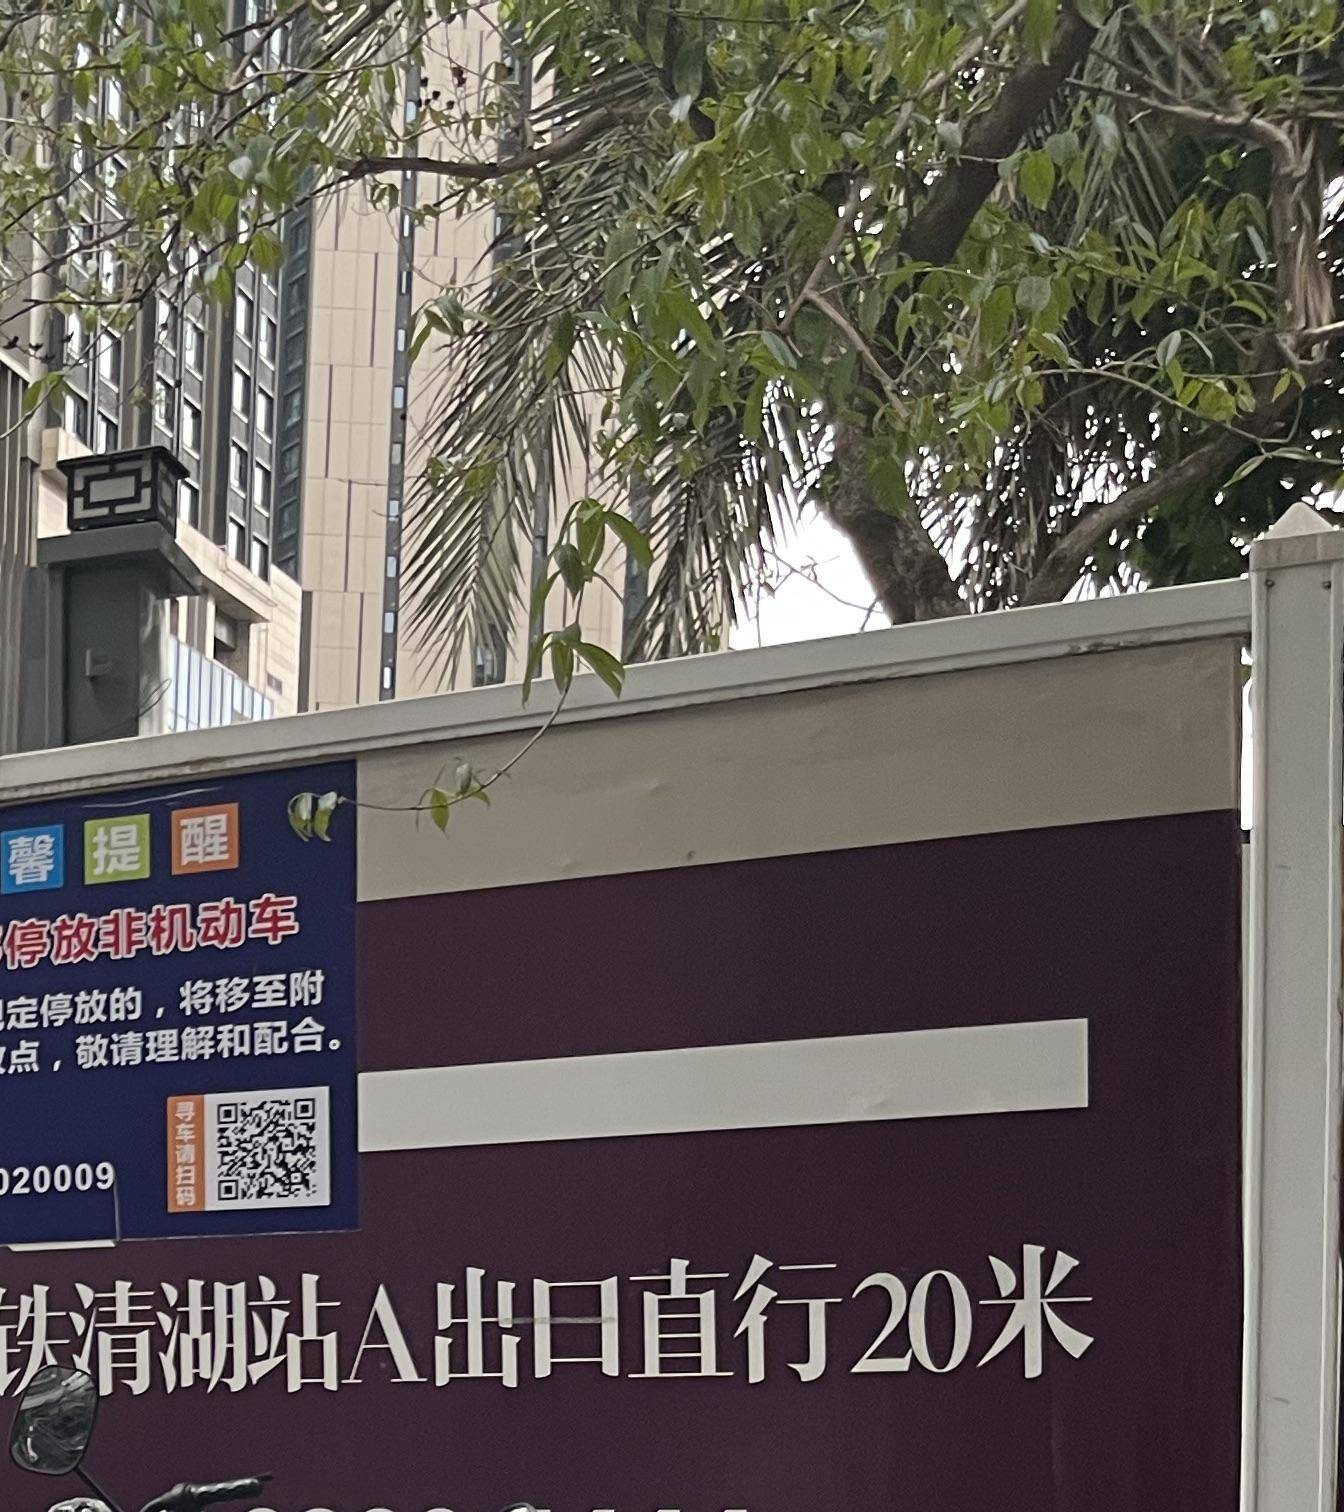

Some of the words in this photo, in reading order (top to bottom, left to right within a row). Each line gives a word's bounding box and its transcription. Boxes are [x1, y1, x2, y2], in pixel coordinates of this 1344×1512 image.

[175, 1101, 196, 1207] 寻车请扫码
